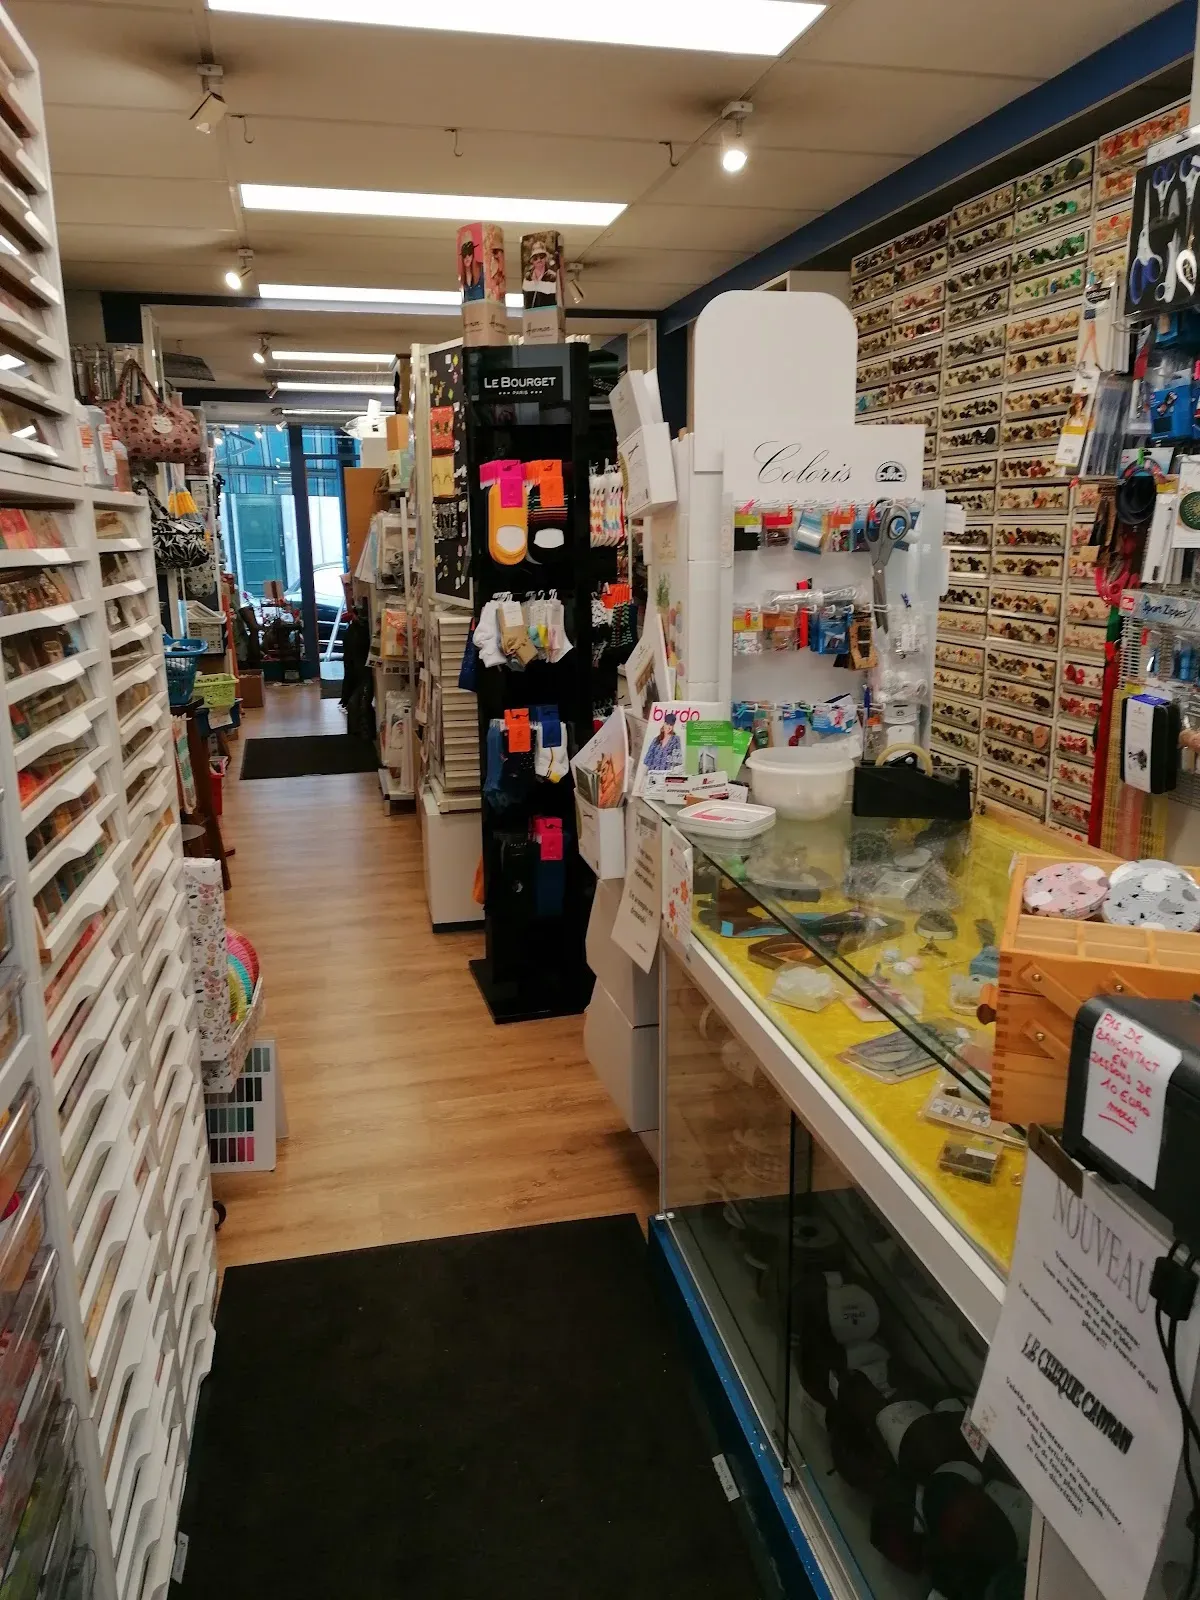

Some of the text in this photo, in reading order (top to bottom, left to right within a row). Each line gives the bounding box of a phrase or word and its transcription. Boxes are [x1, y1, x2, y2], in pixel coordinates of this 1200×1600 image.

[484, 376, 556, 389] LE BOURGET
[753, 440, 853, 484] Coloris
[1100, 1013, 1144, 1044] PAS DE
[1095, 1027, 1161, 1074] BANCONTACT
[1112, 1054, 1128, 1068] EN
[1089, 1051, 1153, 1098] DESSOUS DE
[1100, 1077, 1118, 1095] 10
[1052, 1179, 1153, 1314] NOUVEAU
